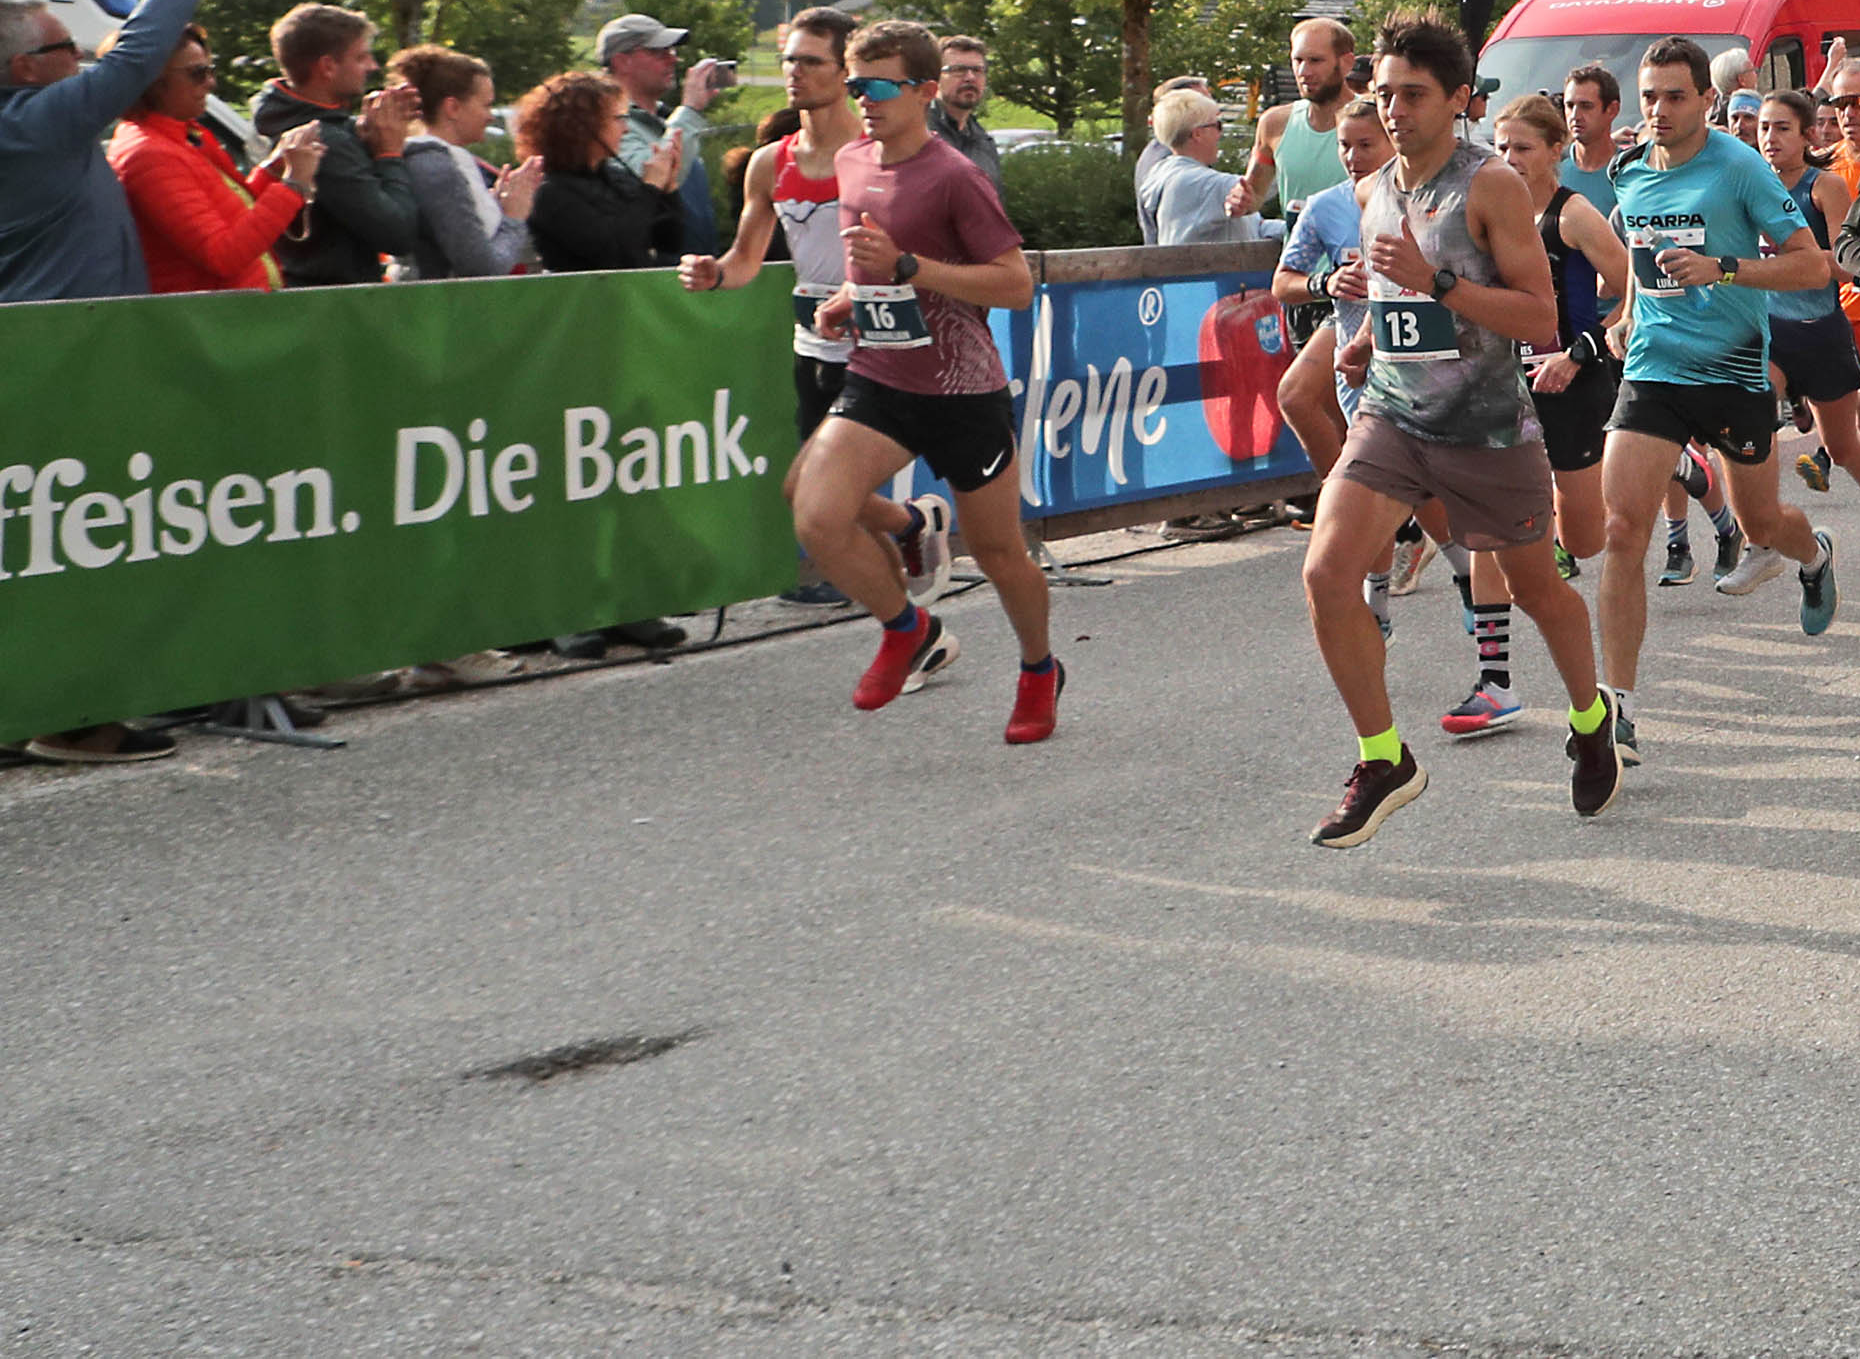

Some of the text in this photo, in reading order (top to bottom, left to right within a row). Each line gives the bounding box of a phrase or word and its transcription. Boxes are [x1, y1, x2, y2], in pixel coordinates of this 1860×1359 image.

[1626, 213, 1706, 228] SCARPA
[865, 303, 896, 329] 16
[1385, 311, 1420, 347] 13
[394, 418, 538, 527] Die
[564, 388, 768, 503] Bank.
